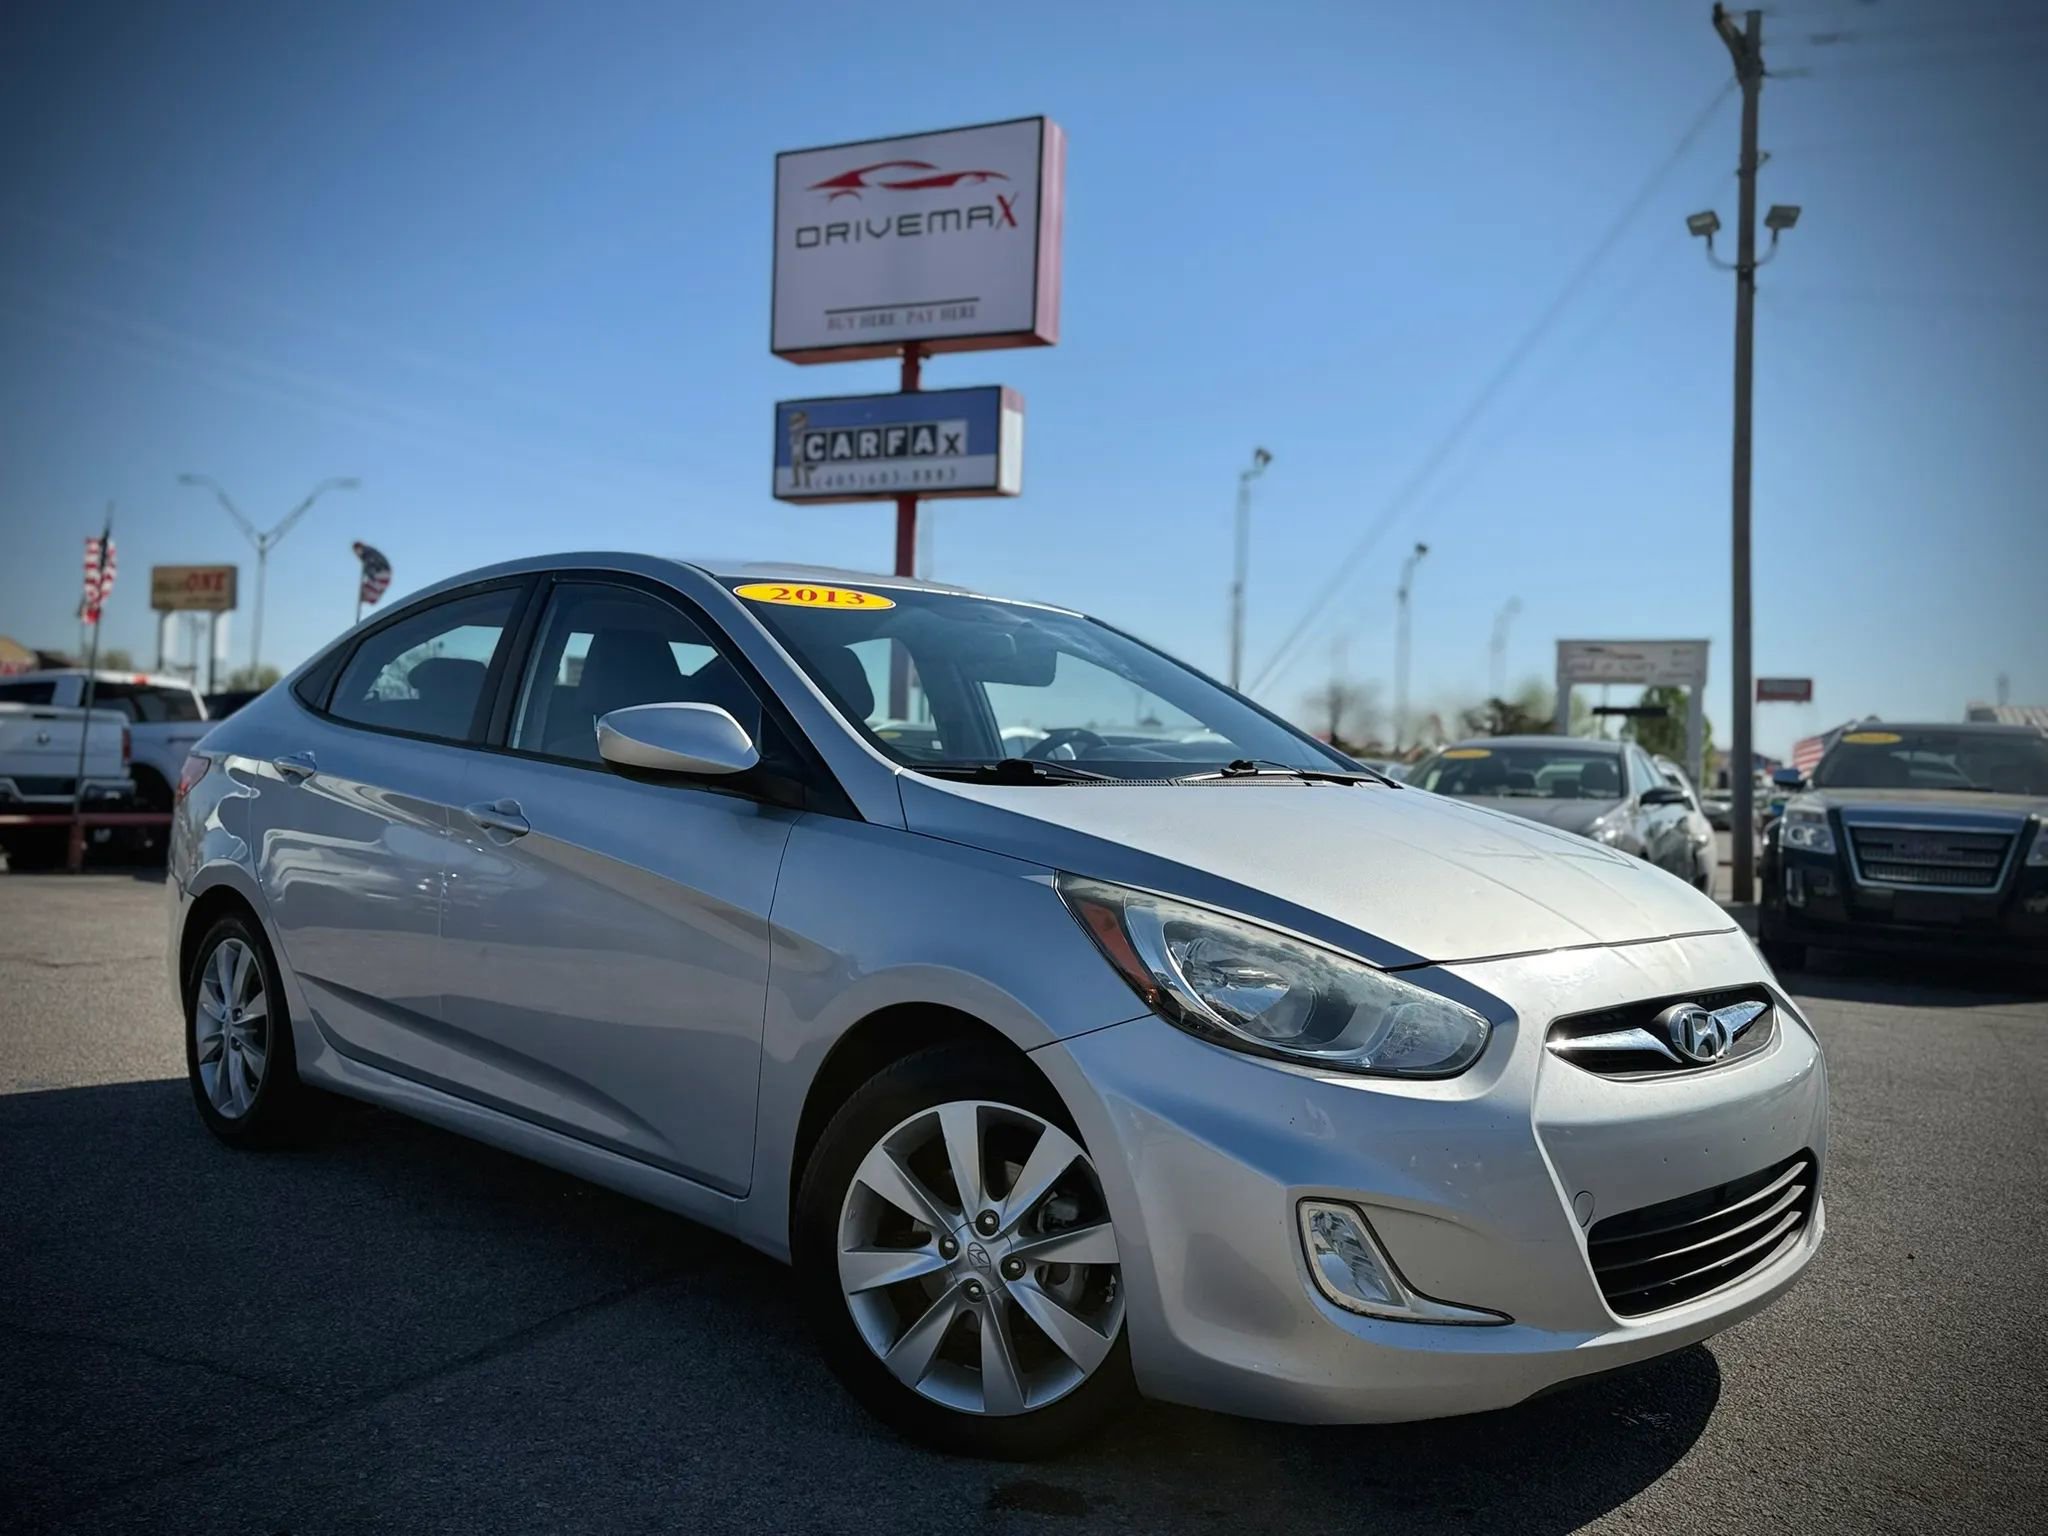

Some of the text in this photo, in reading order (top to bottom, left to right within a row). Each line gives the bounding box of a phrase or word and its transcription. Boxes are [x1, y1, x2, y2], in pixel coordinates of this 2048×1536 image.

[795, 192, 1018, 249] DRIVEMAX
[906, 309, 934, 326] PAY
[770, 587, 865, 605] 2013
